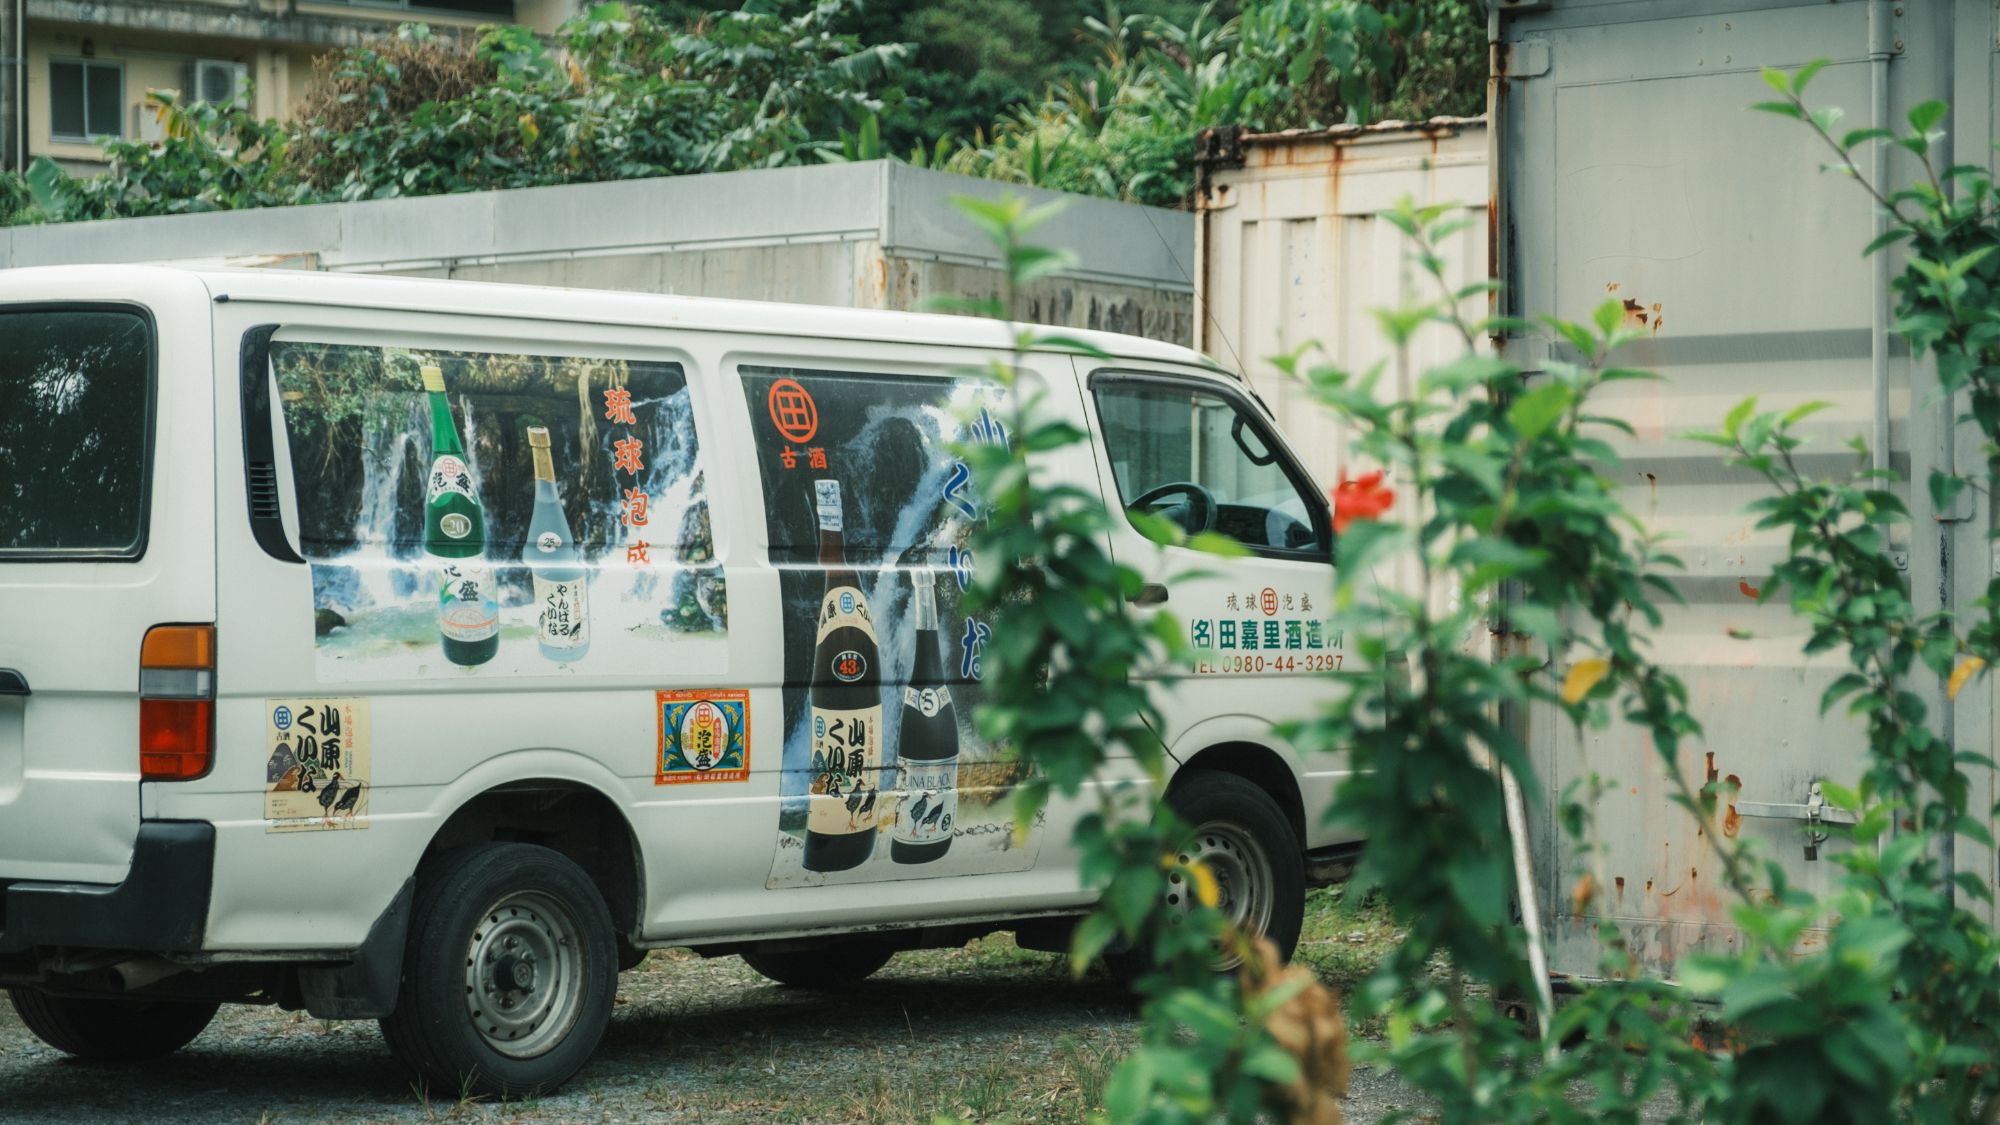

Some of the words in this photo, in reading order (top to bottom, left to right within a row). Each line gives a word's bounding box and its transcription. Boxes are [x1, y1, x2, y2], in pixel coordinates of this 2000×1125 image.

[780, 445, 828, 469] 古酒
[450, 520, 464, 534] 20
[544, 537, 555, 548] 25
[547, 593, 558, 635] くいな
[557, 584, 569, 635] やんばる
[1227, 593, 1258, 611] 琉球
[1282, 592, 1312, 611] 泡盛
[840, 660, 857, 675] 43
[1223, 655, 1343, 673] 0980-44-3297
[921, 692, 934, 711] 5
[297, 705, 318, 793] くいな
[320, 705, 340, 770] 山原
[696, 730, 712, 767] 泡盛
[847, 717, 865, 777] 山原
[827, 718, 845, 798] くいな
